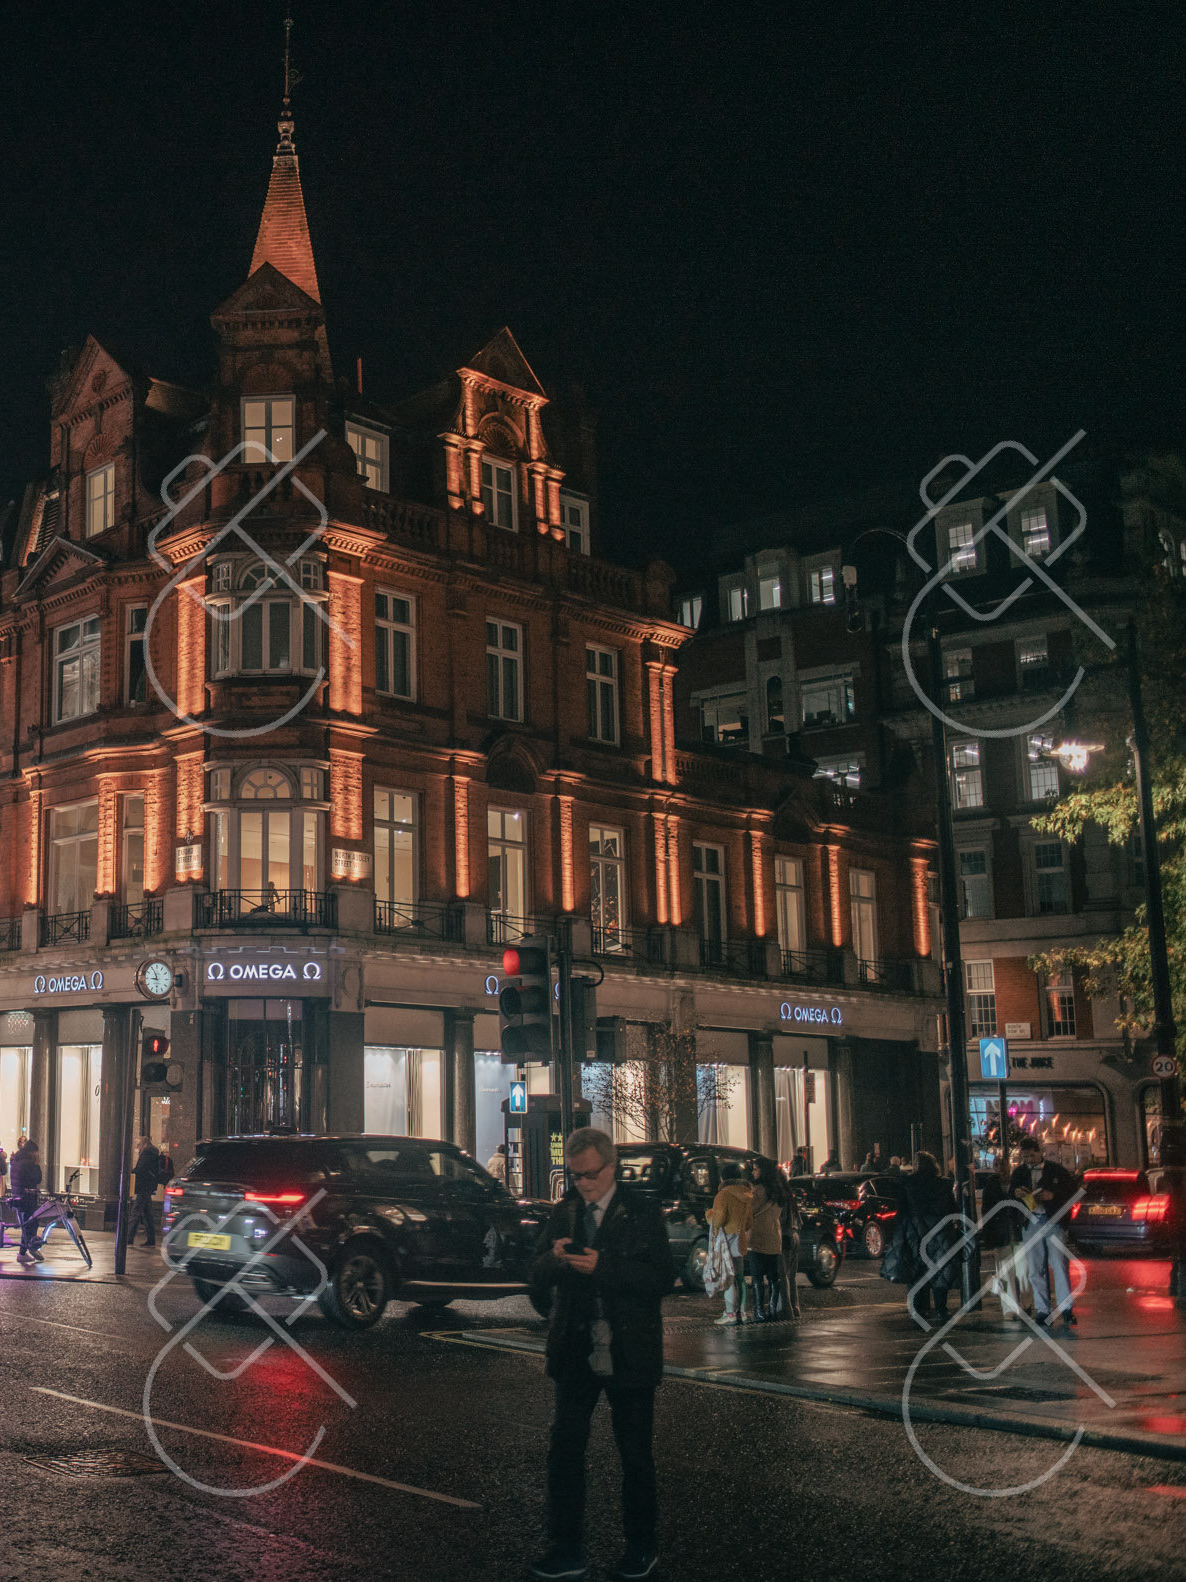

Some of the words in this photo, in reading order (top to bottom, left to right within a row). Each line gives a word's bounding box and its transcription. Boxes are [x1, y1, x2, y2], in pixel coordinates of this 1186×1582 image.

[229, 964, 297, 979] OMEGA
[48, 976, 87, 992] OMEGA
[794, 1006, 829, 1023] OMEGA
[1155, 1061, 1174, 1072] 20
